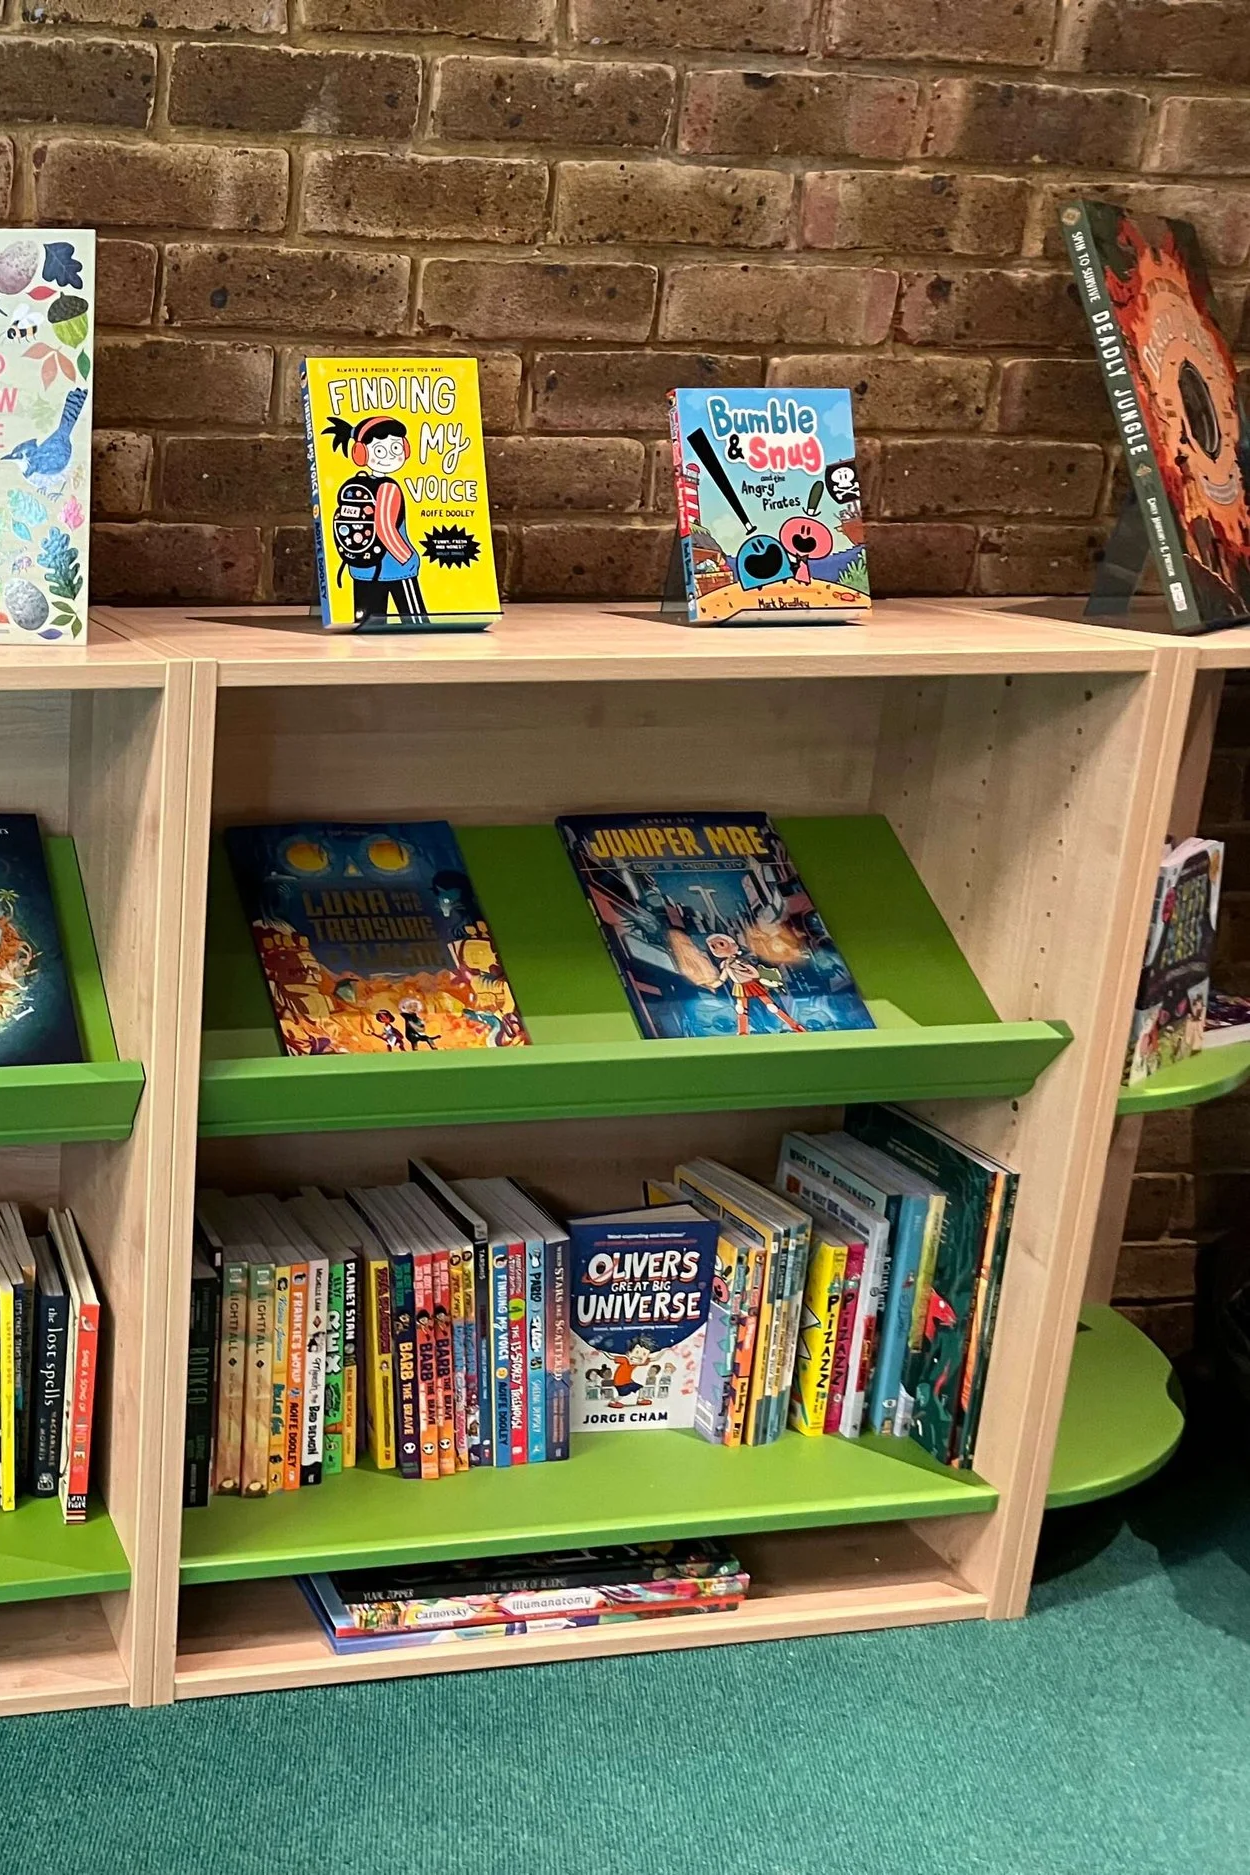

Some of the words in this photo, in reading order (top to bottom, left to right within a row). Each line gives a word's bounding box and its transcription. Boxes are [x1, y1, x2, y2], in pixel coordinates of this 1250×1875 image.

[1070, 230, 1088, 252] SPIN
[1076, 251, 1091, 266] TO
[1080, 265, 1102, 303] SURVIVE
[1089, 309, 1125, 380] DEADLY
[327, 376, 456, 415] FINDING
[708, 397, 816, 437] Bumble
[1112, 385, 1148, 457] JUNGLE
[728, 434, 744, 459] &
[748, 436, 822, 472] Snug
[404, 475, 477, 502] VOICE
[741, 480, 775, 499] Angry
[763, 496, 800, 511] Pirates
[421, 509, 444, 518] AOIFE
[446, 509, 475, 518] DOOLEY
[590, 827, 705, 858] JUNIPER
[703, 826, 769, 856] MAE
[303, 890, 390, 916] LUNA
[309, 916, 438, 942] TREASURE
[345, 1262, 354, 1305] PLANET
[530, 1272, 541, 1302] PABLO
[611, 1281, 648, 1293] GREAT
[652, 1280, 671, 1292] BIG
[47, 1307, 57, 1323] the
[227, 1290, 239, 1352] LIGHTFALL
[255, 1293, 266, 1354] LIGHTFALL
[576, 1291, 701, 1325] UNIVERSE
[345, 1309, 355, 1339] STAN
[511, 1325, 519, 1339] THE
[46, 1327, 63, 1357] lost
[187, 1347, 209, 1405] BOOKED
[399, 1341, 413, 1380] BARB
[419, 1342, 433, 1381] BARB
[510, 1341, 522, 1382] 13-STOREY
[38, 1362, 61, 1406] spells
[402, 1382, 411, 1401] THE
[426, 1382, 434, 1397] THE
[436, 1337, 449, 1377] BARB
[443, 1394, 451, 1420] BRAVE
[402, 1403, 413, 1435] BRAVE
[426, 1399, 435, 1424] BRAVE
[511, 1386, 523, 1429] TREEHOUSE
[583, 1413, 625, 1424] JORGE
[630, 1412, 668, 1422] CHAM
[415, 1605, 468, 1621] Carnovsky
